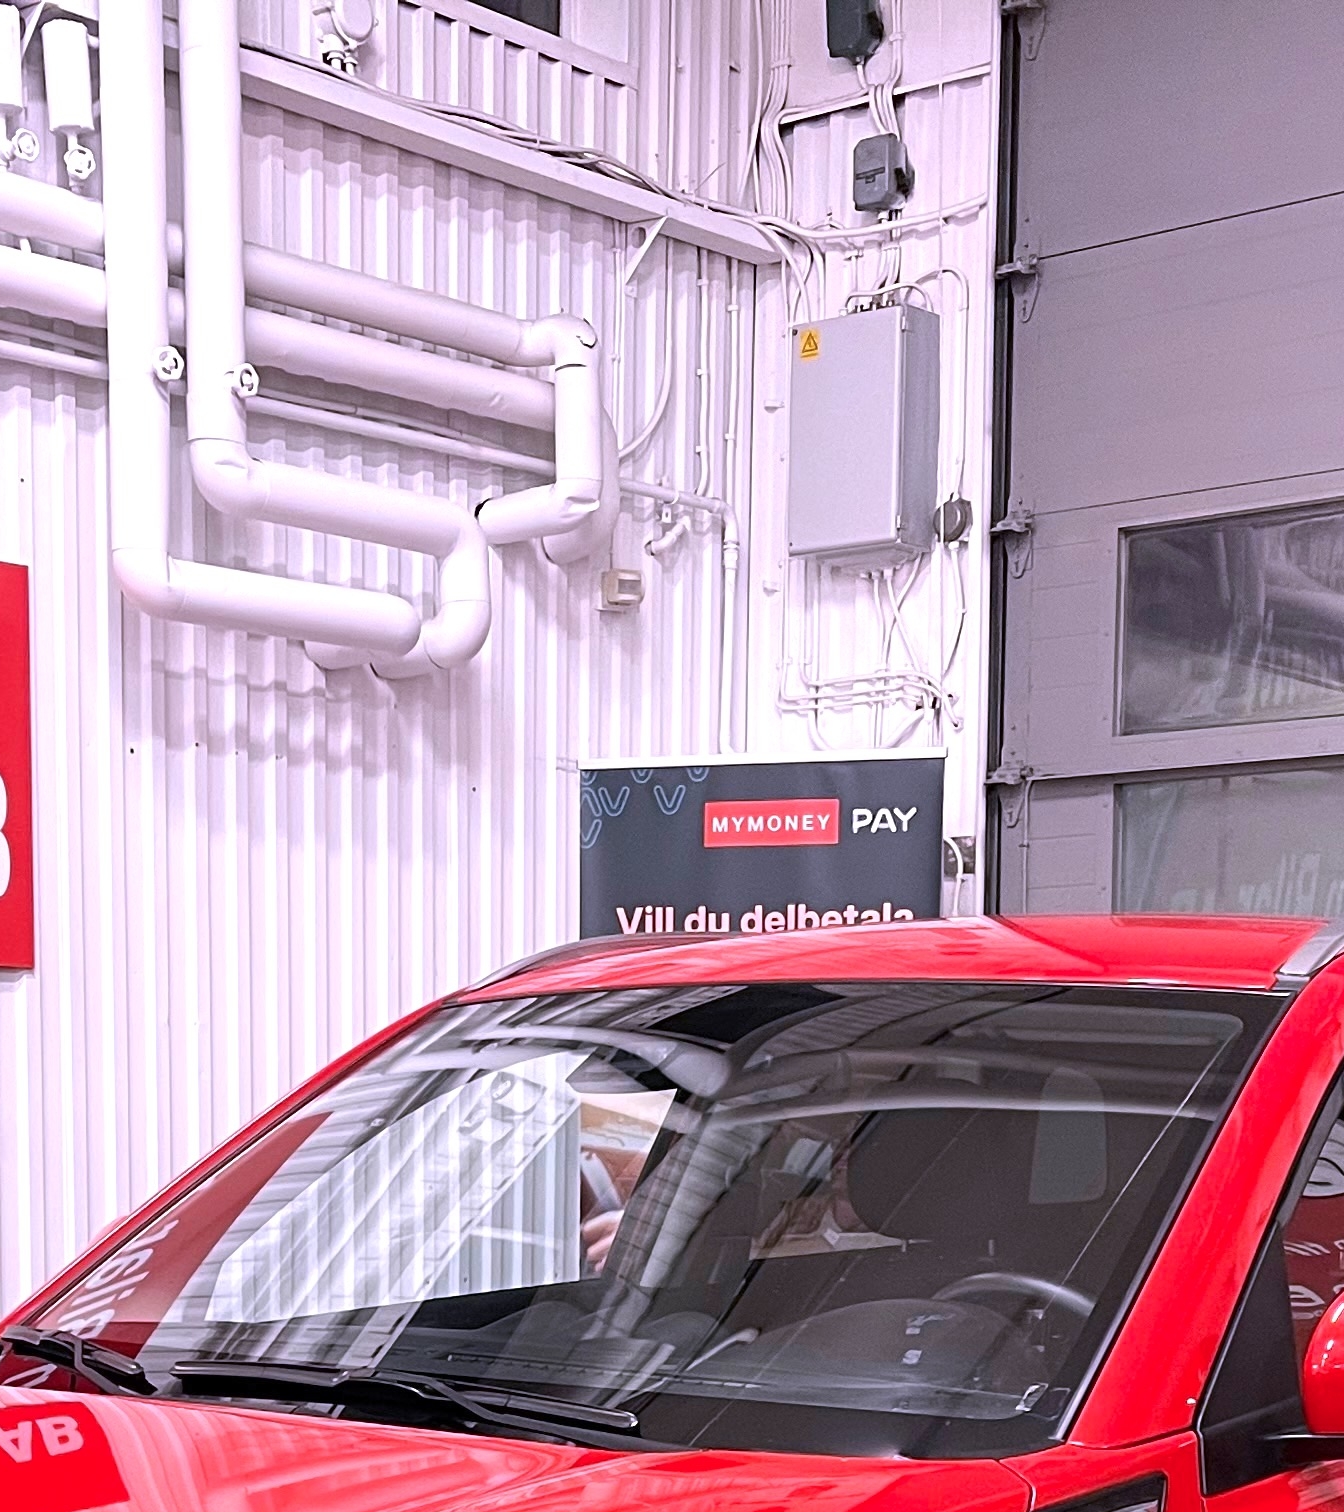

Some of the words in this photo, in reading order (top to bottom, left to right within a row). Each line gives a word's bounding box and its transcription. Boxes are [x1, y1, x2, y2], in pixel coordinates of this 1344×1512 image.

[712, 814, 831, 833] MYMONEY
[851, 806, 918, 835] PAY
[615, 905, 674, 935] Vill
[684, 905, 730, 933] du
